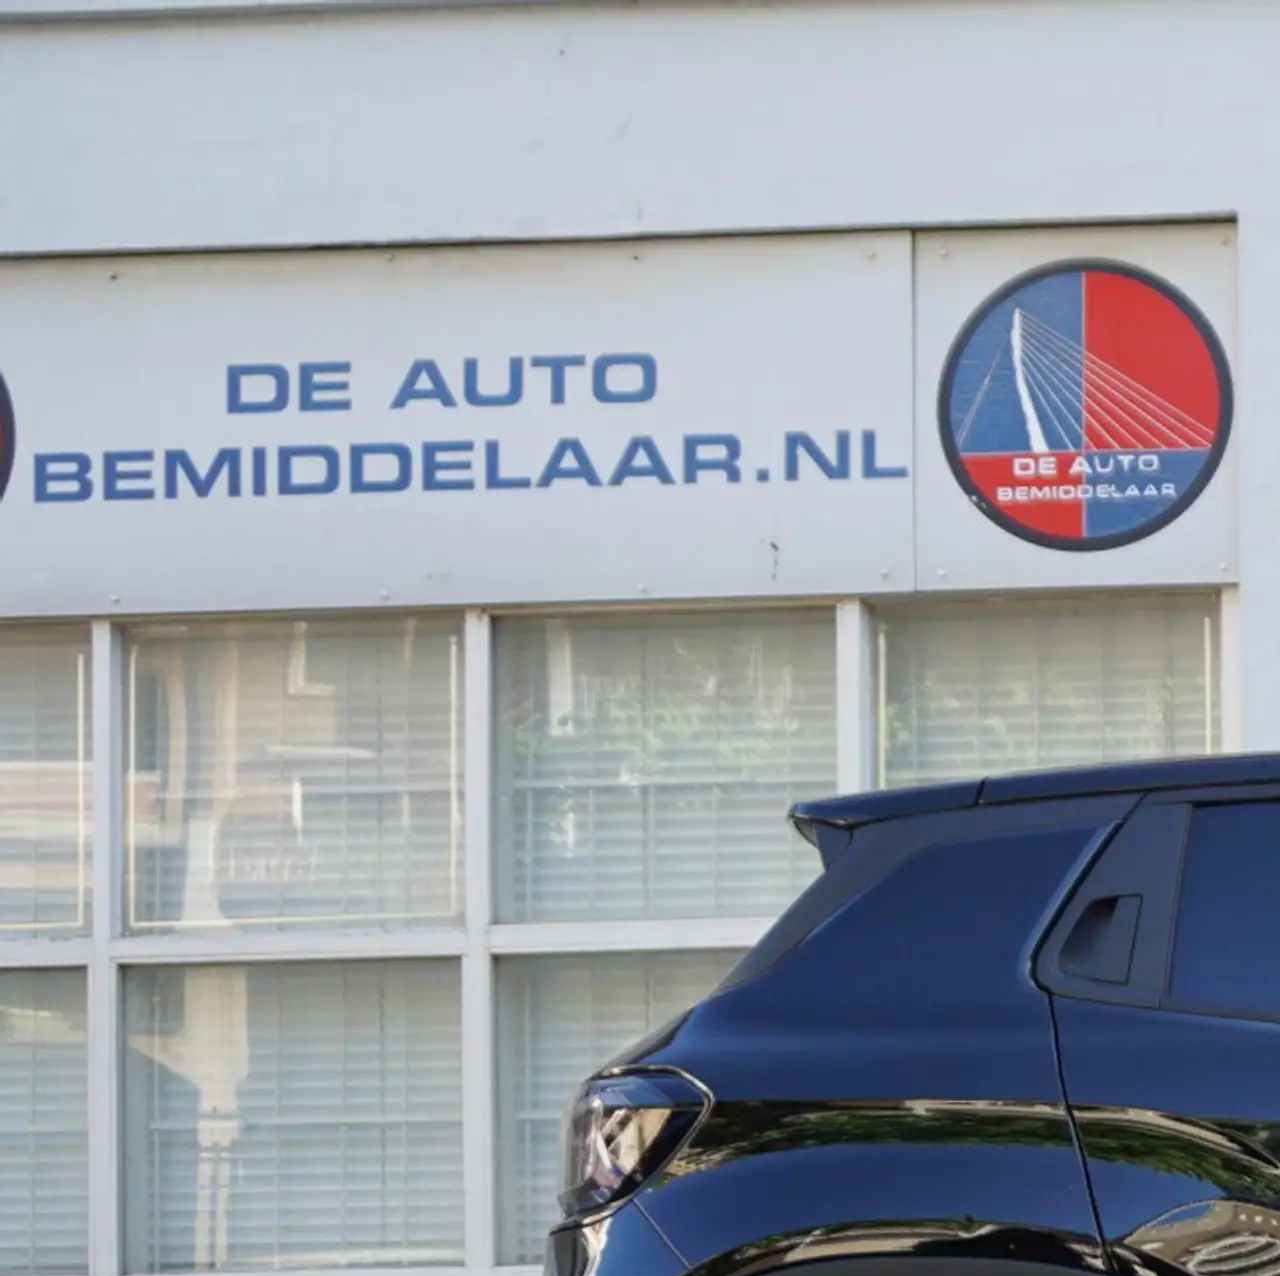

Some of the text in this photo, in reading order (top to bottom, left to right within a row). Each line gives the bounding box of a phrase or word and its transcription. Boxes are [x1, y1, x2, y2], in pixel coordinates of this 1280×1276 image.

[226, 353, 659, 415] DE AUTO
[33, 430, 909, 503] BEMIDDELAAR.NL
[1012, 454, 1160, 477] DE AUTO
[996, 482, 1177, 502] BEMIDDELAAR
